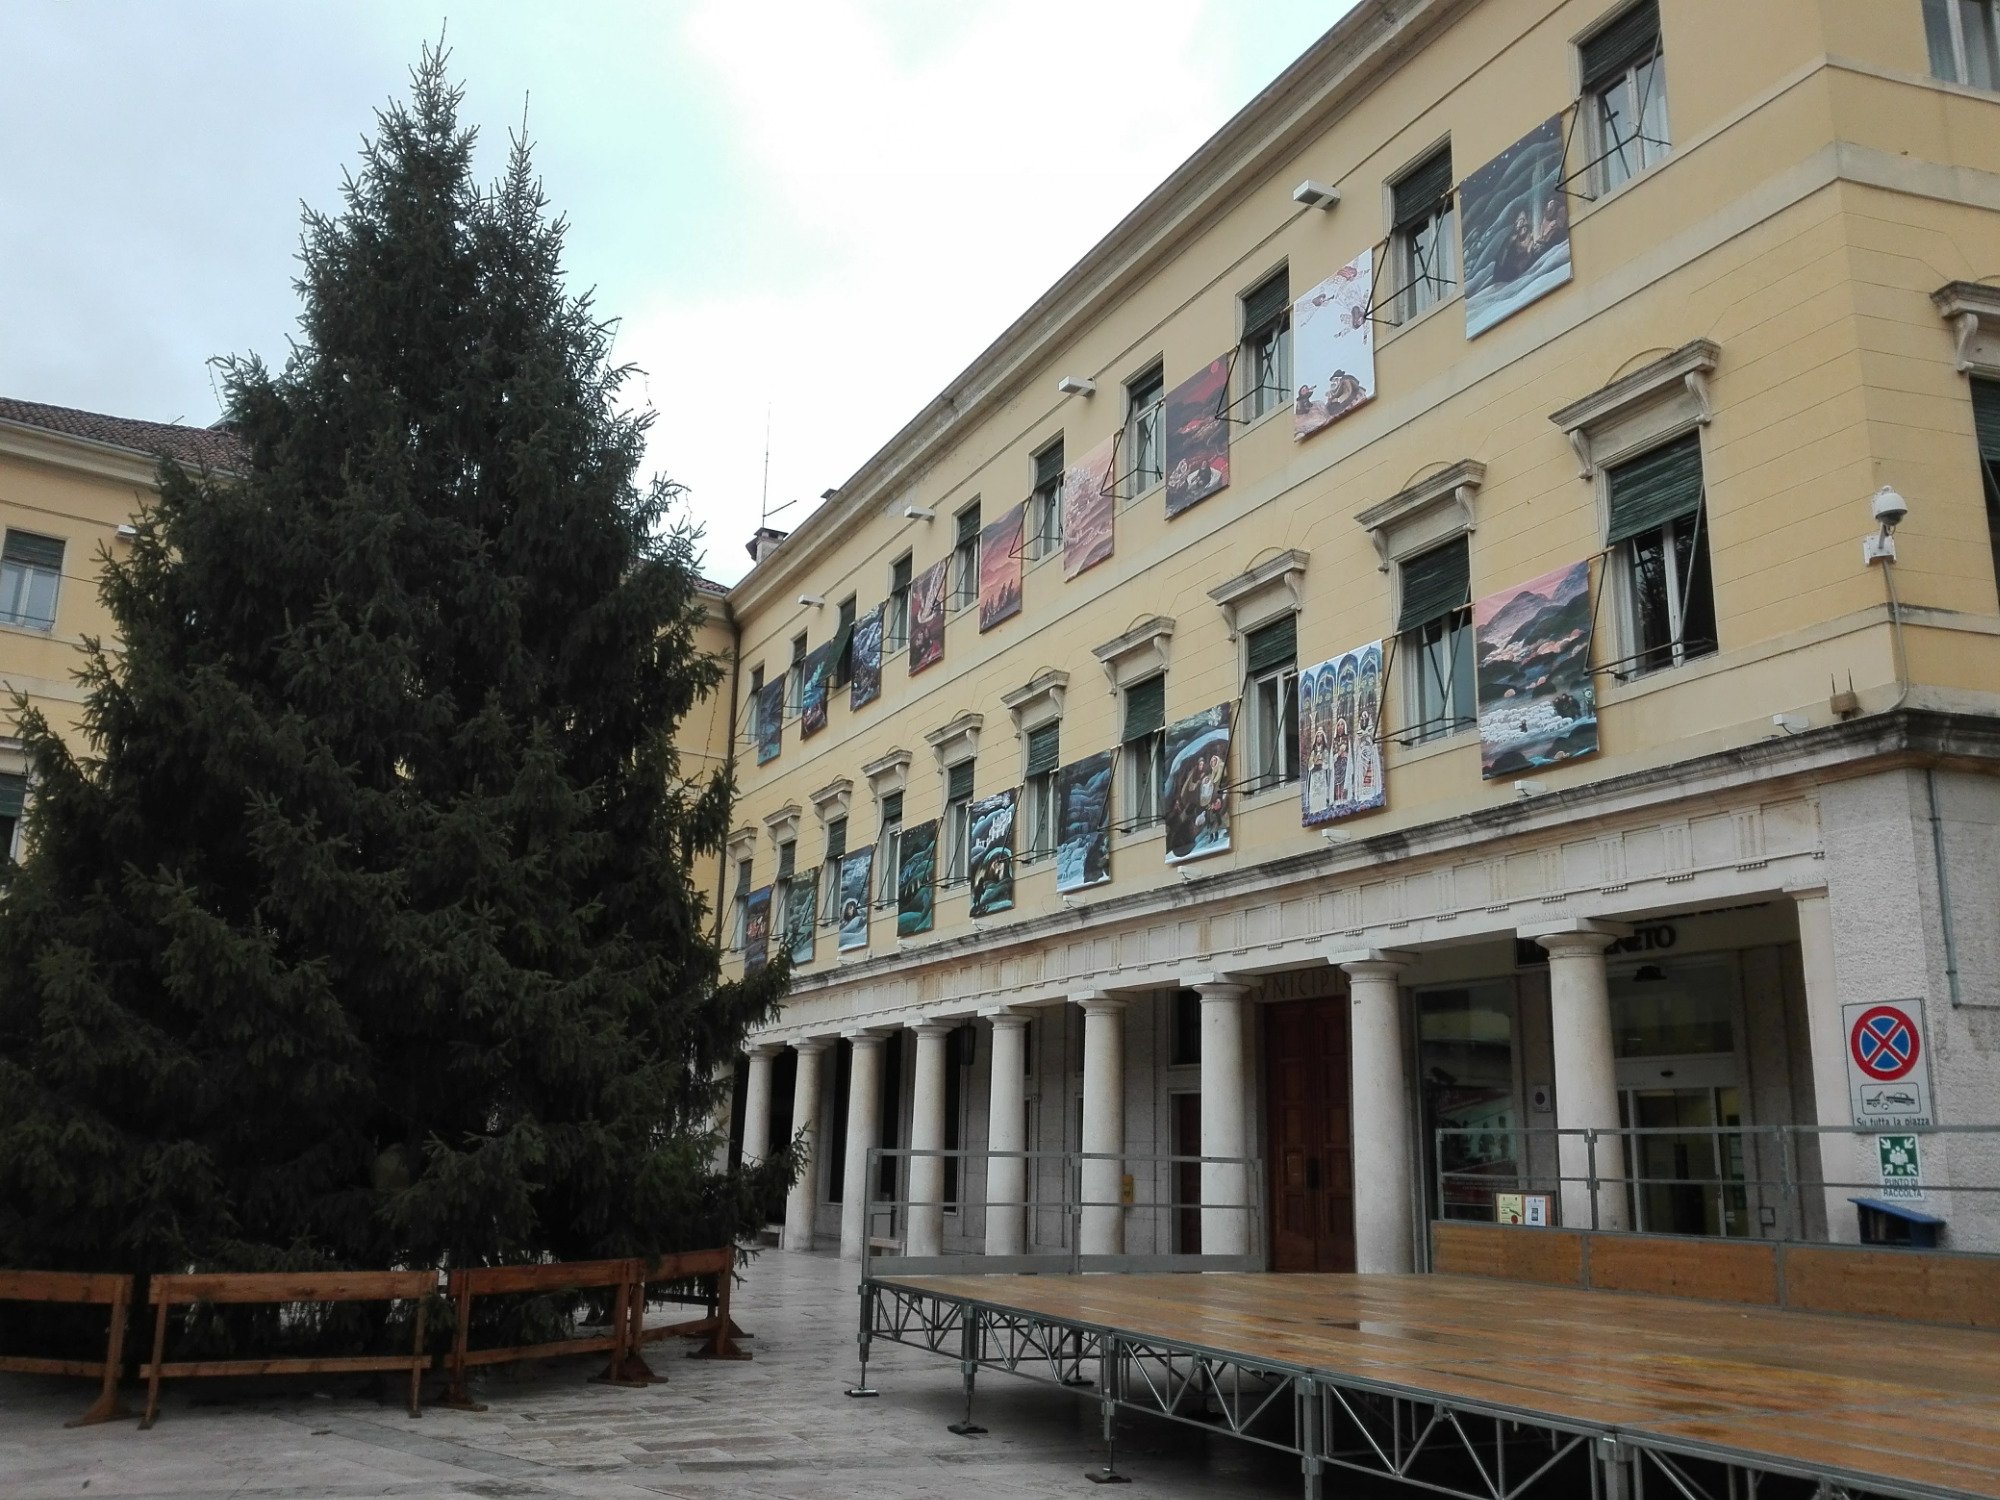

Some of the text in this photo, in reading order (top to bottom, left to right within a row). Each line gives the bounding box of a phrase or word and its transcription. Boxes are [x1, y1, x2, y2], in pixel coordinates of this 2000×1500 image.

[1856, 1116, 1930, 1126] Su tutta la piazza
[1884, 1178, 1918, 1186] PUNTO DI
[1883, 1187, 1922, 1198] RACCOLTA
